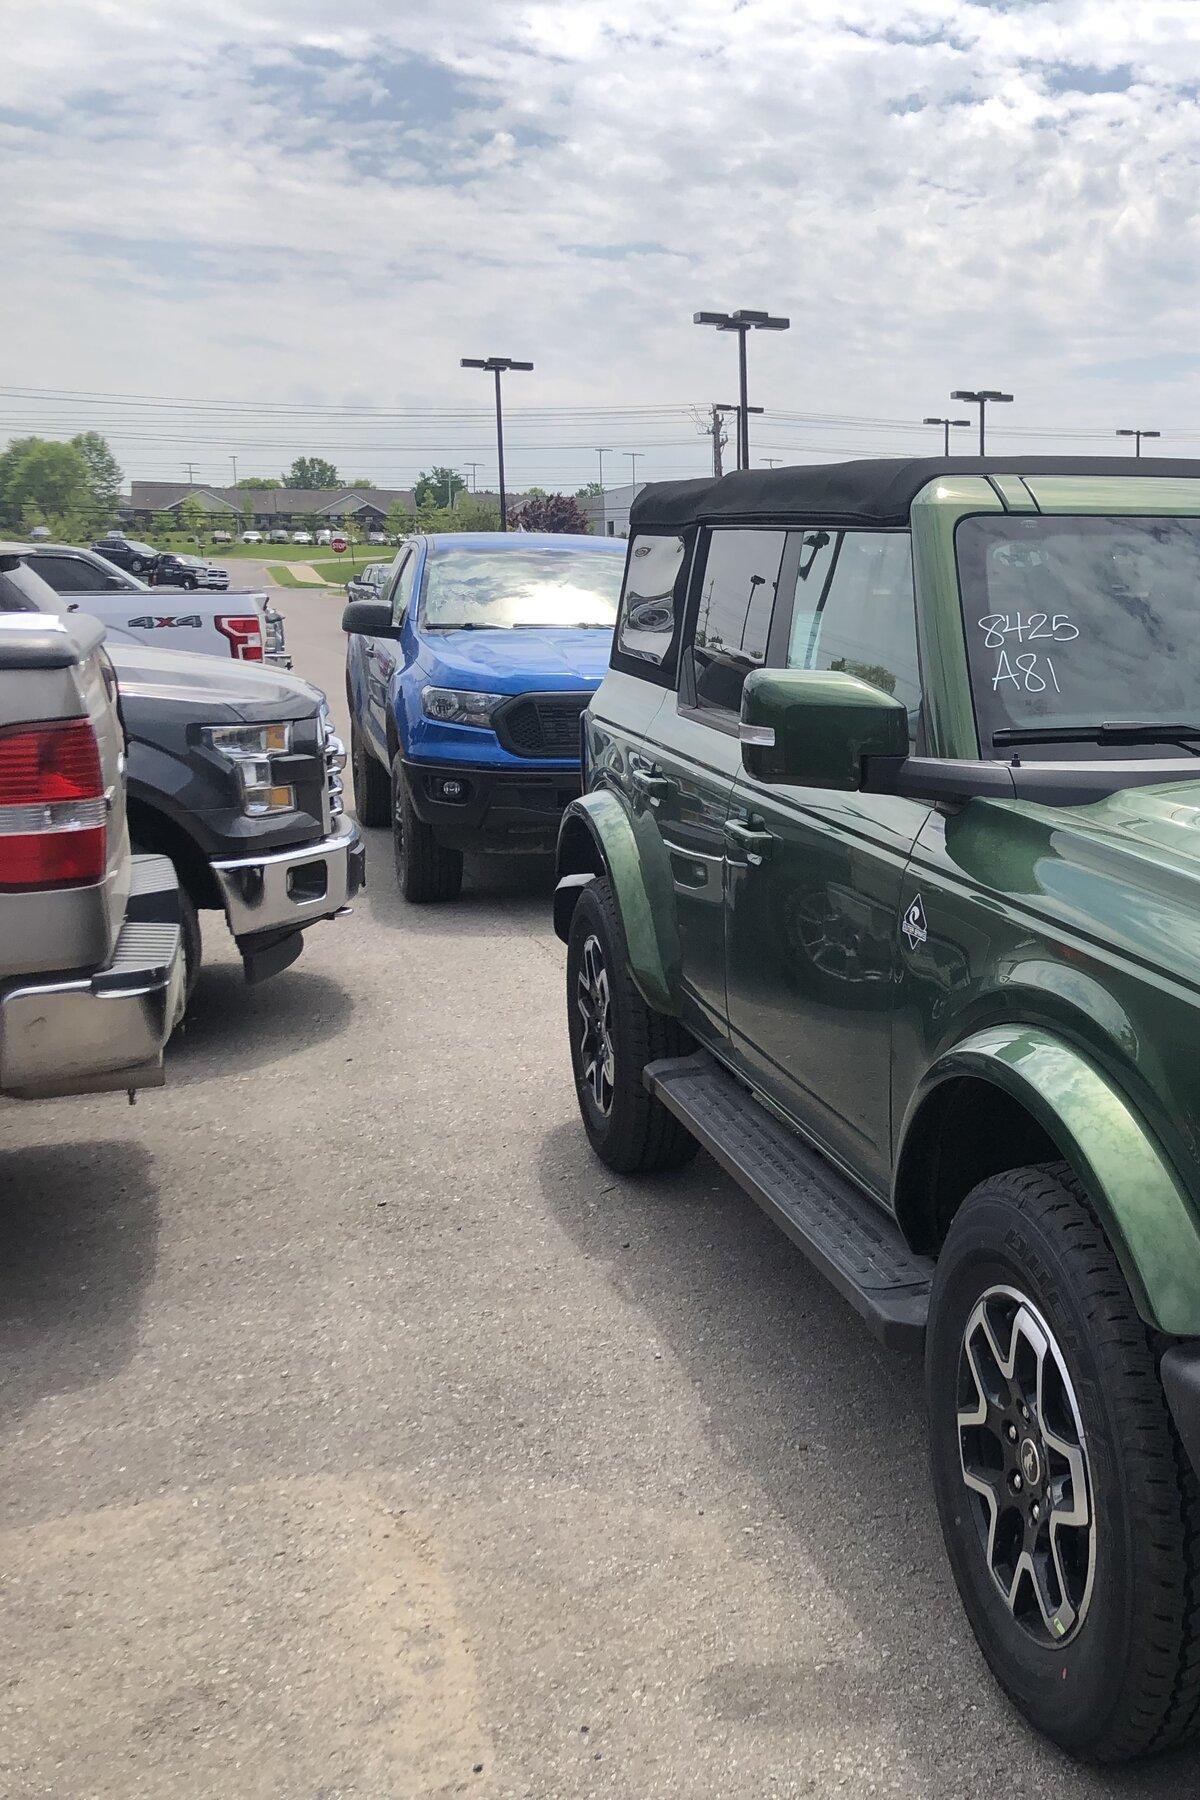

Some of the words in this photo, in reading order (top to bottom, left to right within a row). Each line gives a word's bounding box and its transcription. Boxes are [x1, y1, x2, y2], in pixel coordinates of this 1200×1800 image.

[332, 542, 346, 550] STOP
[978, 611, 1080, 648] 8425
[991, 650, 1061, 693] A81
